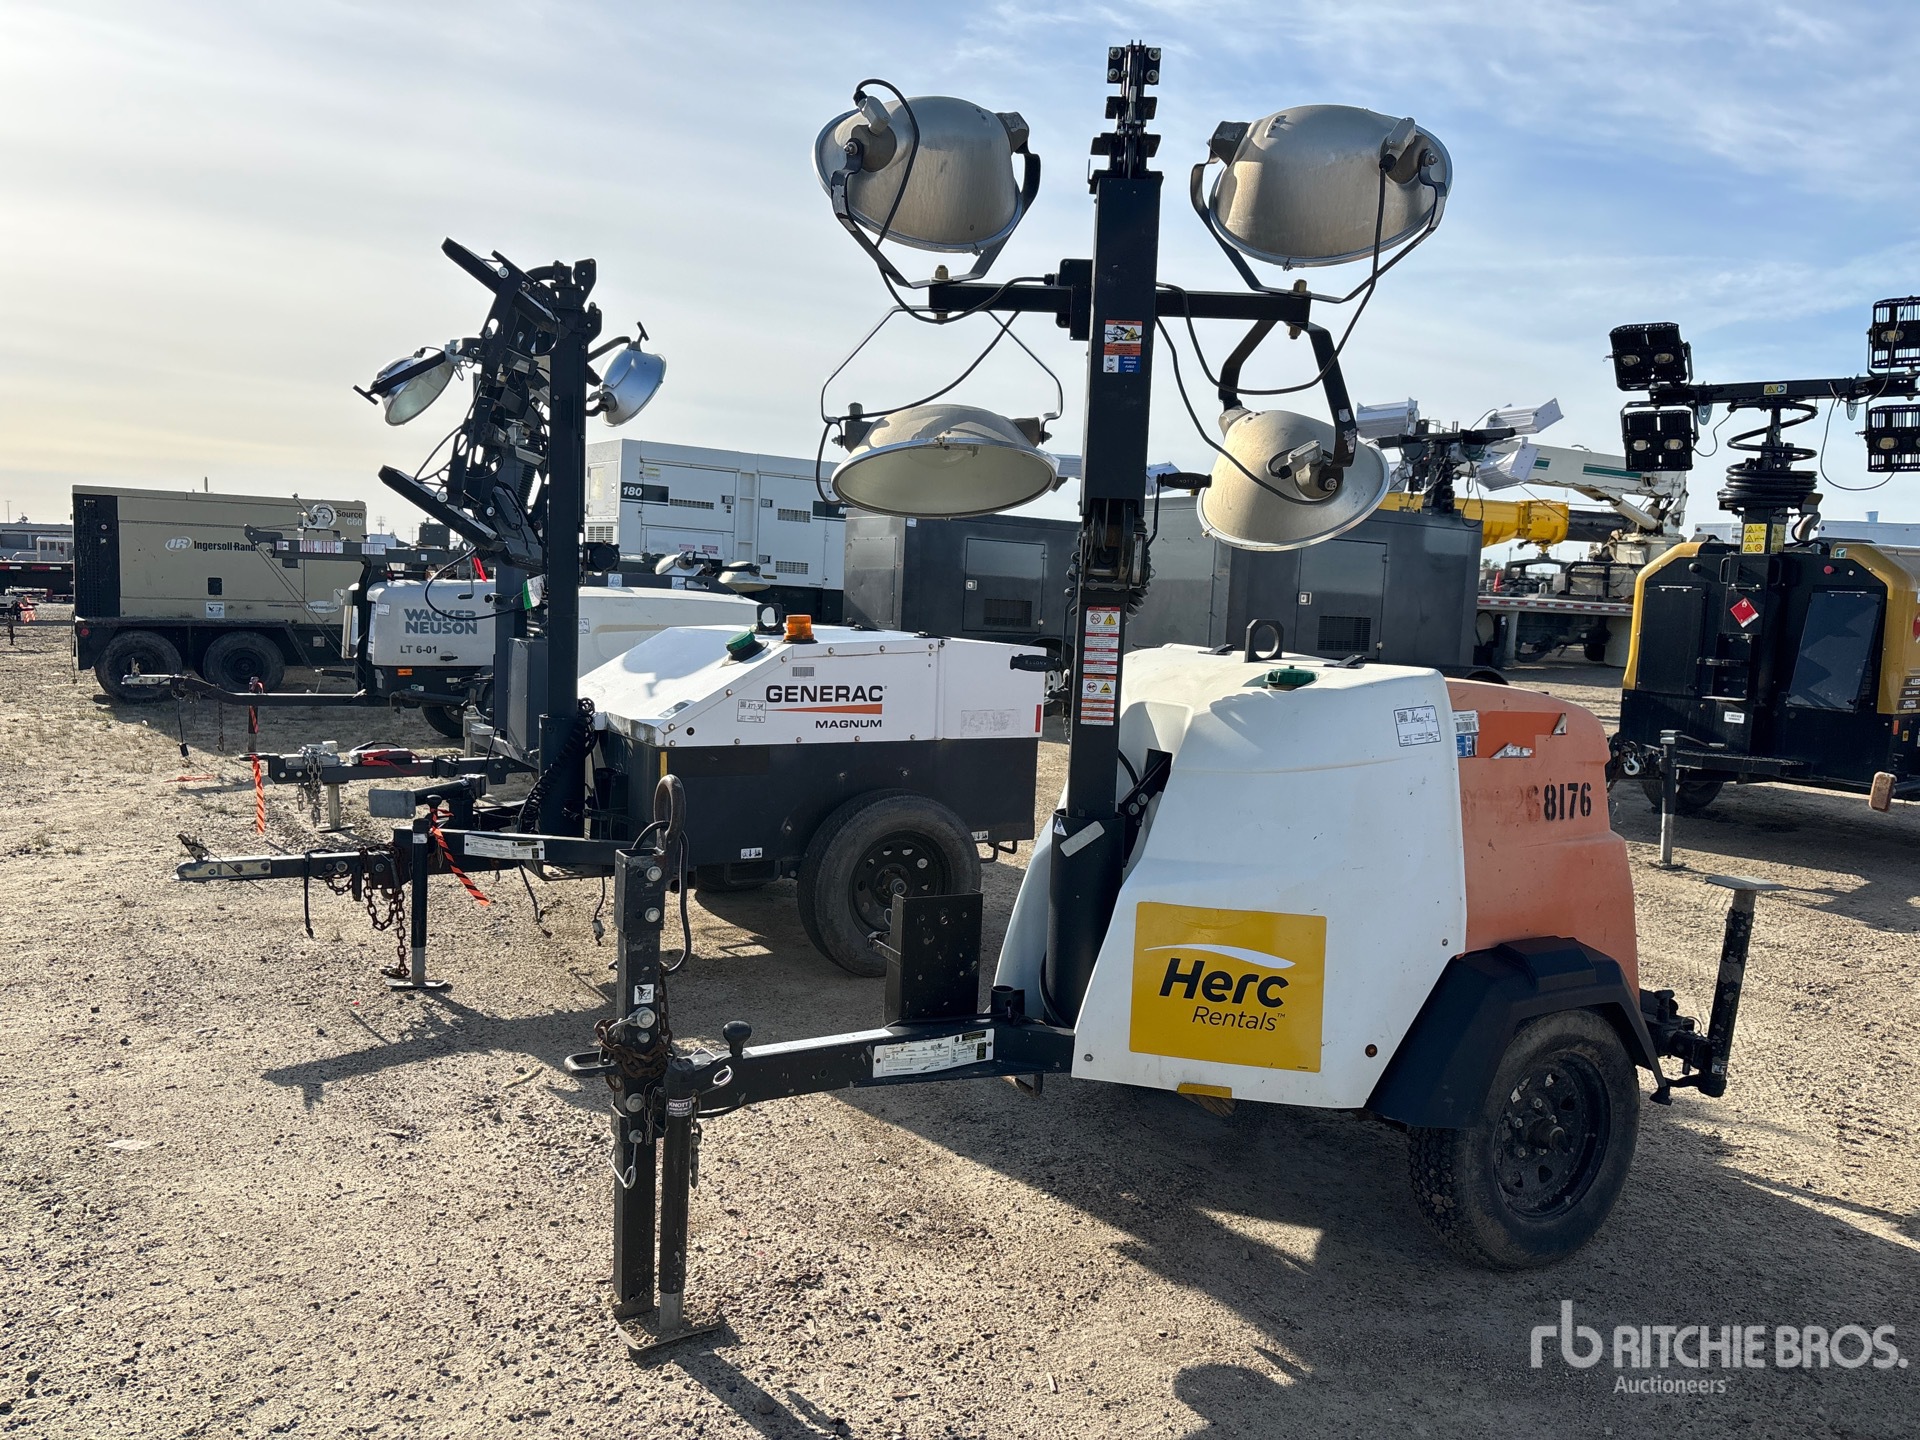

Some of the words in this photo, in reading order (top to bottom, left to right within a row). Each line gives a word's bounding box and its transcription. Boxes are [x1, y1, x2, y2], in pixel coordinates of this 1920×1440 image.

[623, 485, 643, 497] 180
[336, 510, 363, 519] Source
[404, 608, 477, 622] WACKER
[405, 621, 478, 635] NEUSON
[400, 645, 413, 654] LT
[416, 645, 438, 654] 6-01
[765, 685, 884, 703] GENERAC
[815, 719, 882, 729] MAGNUM
[1158, 957, 1290, 1009] Herc
